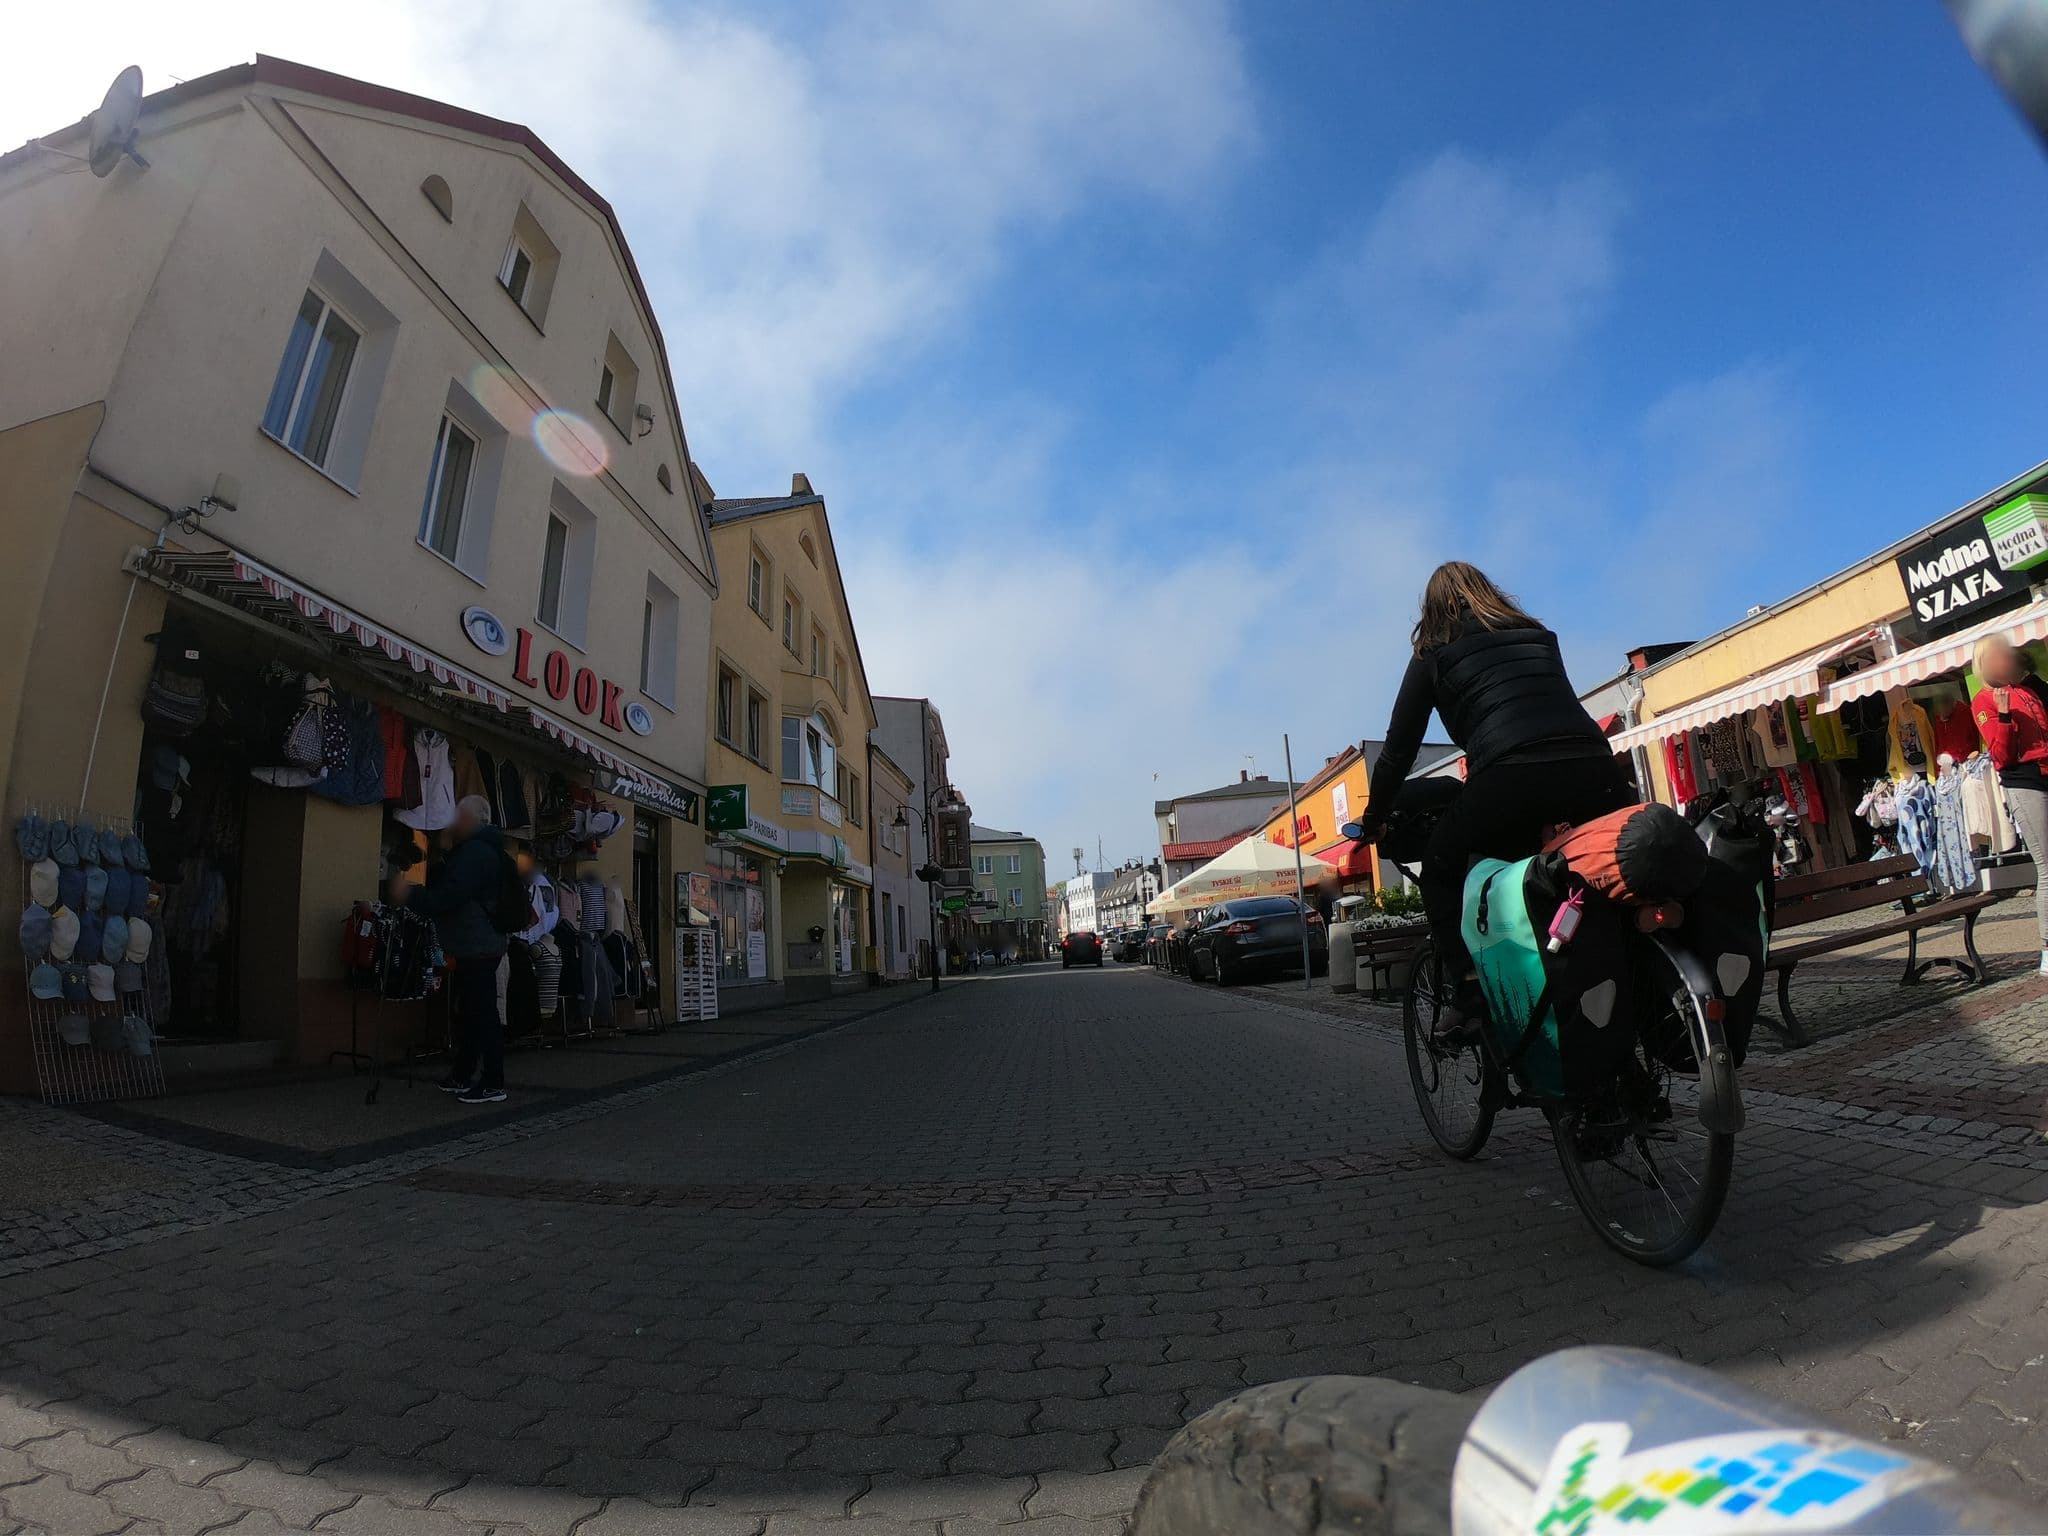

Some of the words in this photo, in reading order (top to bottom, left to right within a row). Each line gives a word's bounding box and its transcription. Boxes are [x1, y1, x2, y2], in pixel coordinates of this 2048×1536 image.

[1997, 527, 2037, 551] Modna
[2001, 540, 2043, 564] SZAFA
[1907, 538, 1990, 594] Modna
[1916, 568, 2004, 623] SZAFA
[512, 627, 624, 733] LOOK
[754, 822, 778, 841] PARIBAS
[1211, 876, 1232, 888] TYSKIE
